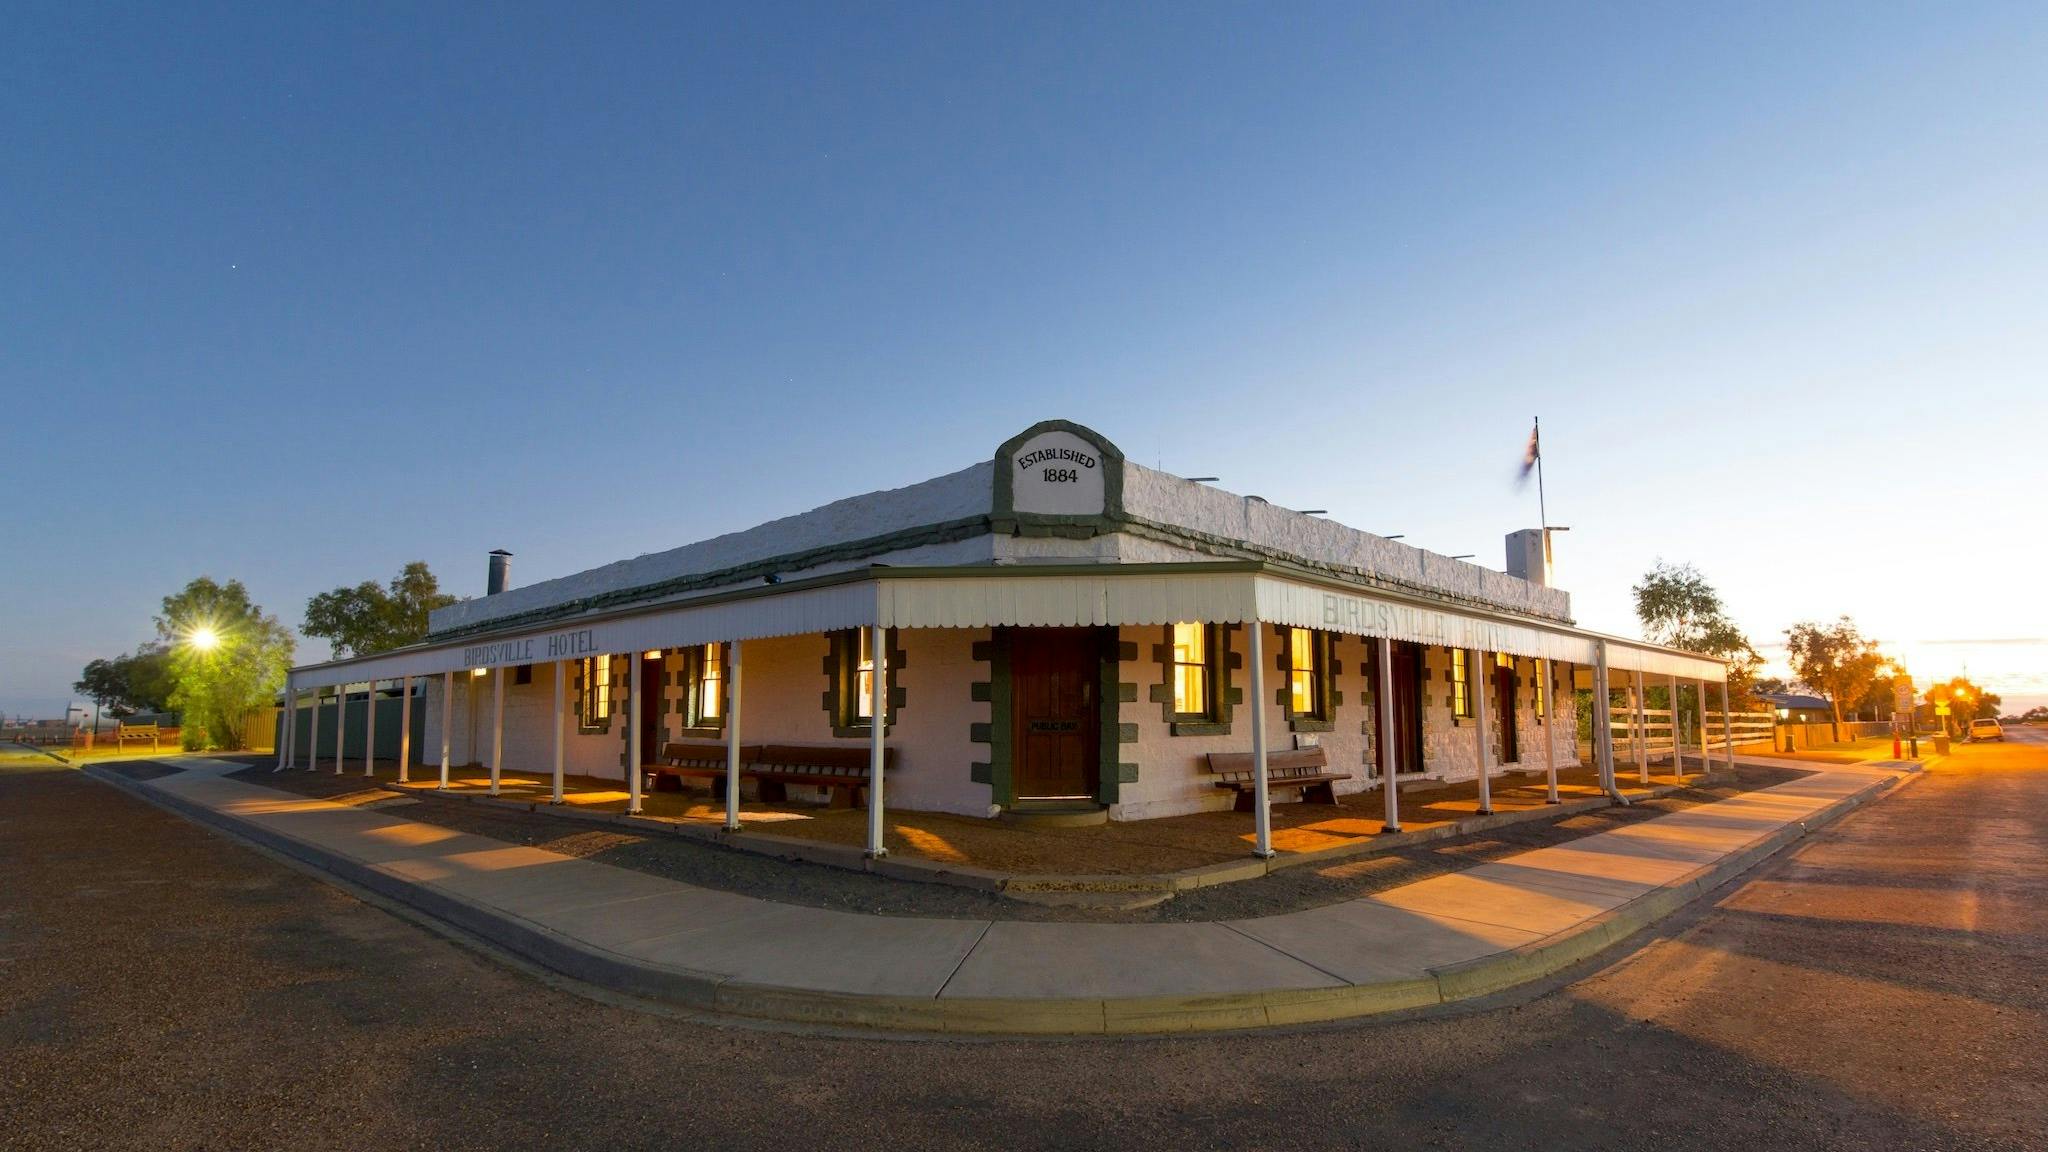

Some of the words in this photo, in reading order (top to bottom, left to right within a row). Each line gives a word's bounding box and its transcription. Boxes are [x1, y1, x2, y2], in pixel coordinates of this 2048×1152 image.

[1018, 448, 1095, 470] ESTABLISHED
[1043, 468, 1078, 482] 1884
[1323, 593, 1444, 639] BIRDSVILLE
[464, 639, 533, 666] BIRDSVILLE
[548, 629, 599, 657] HOTEL
